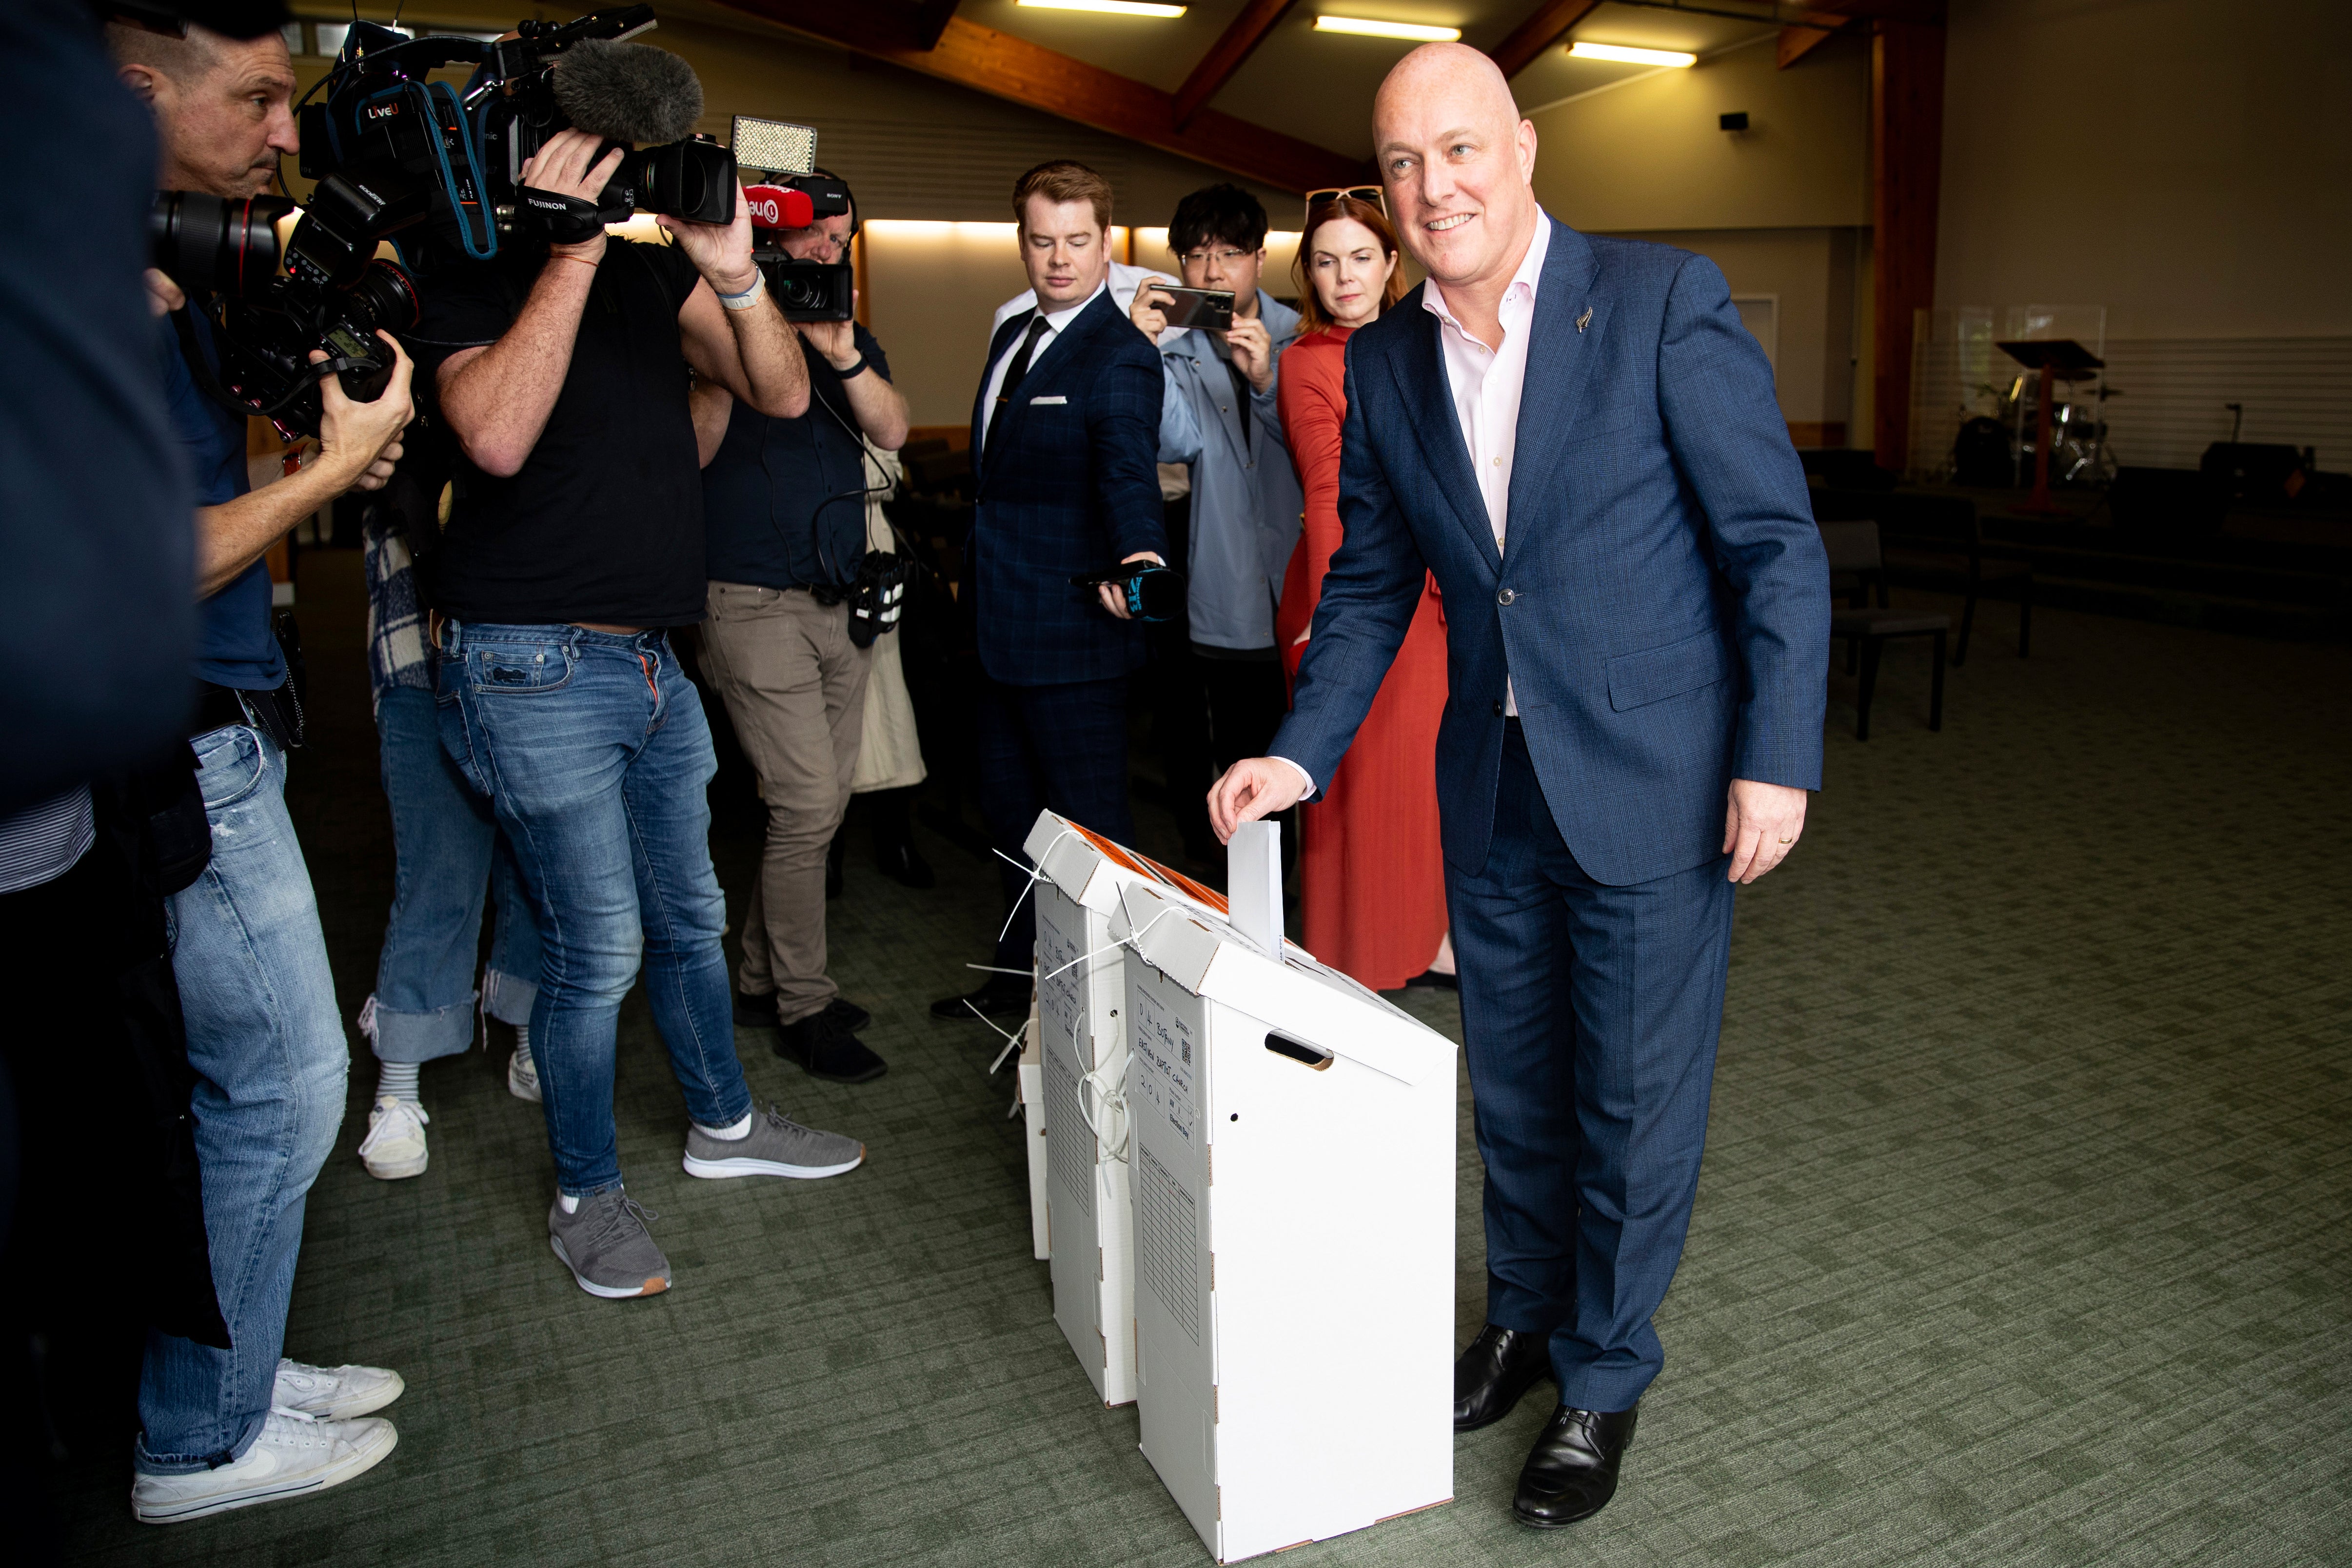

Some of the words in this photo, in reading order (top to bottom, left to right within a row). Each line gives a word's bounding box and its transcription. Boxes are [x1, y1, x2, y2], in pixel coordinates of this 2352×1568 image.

[368, 102, 399, 119] LiveU
[527, 198, 567, 210] FUJINON
[1140, 1003, 1143, 1015] 0
[1147, 1010, 1152, 1026] 4
[1157, 1022, 1174, 1052] BOTANY
[1156, 1056, 1171, 1077] BAPTIST
[1172, 1074, 1188, 1094] CHURCH
[1141, 1074, 1146, 1089] 2
[1148, 1084, 1152, 1095] 0
[1156, 1091, 1160, 1105] 4
[1170, 1113, 1183, 1132] Election
